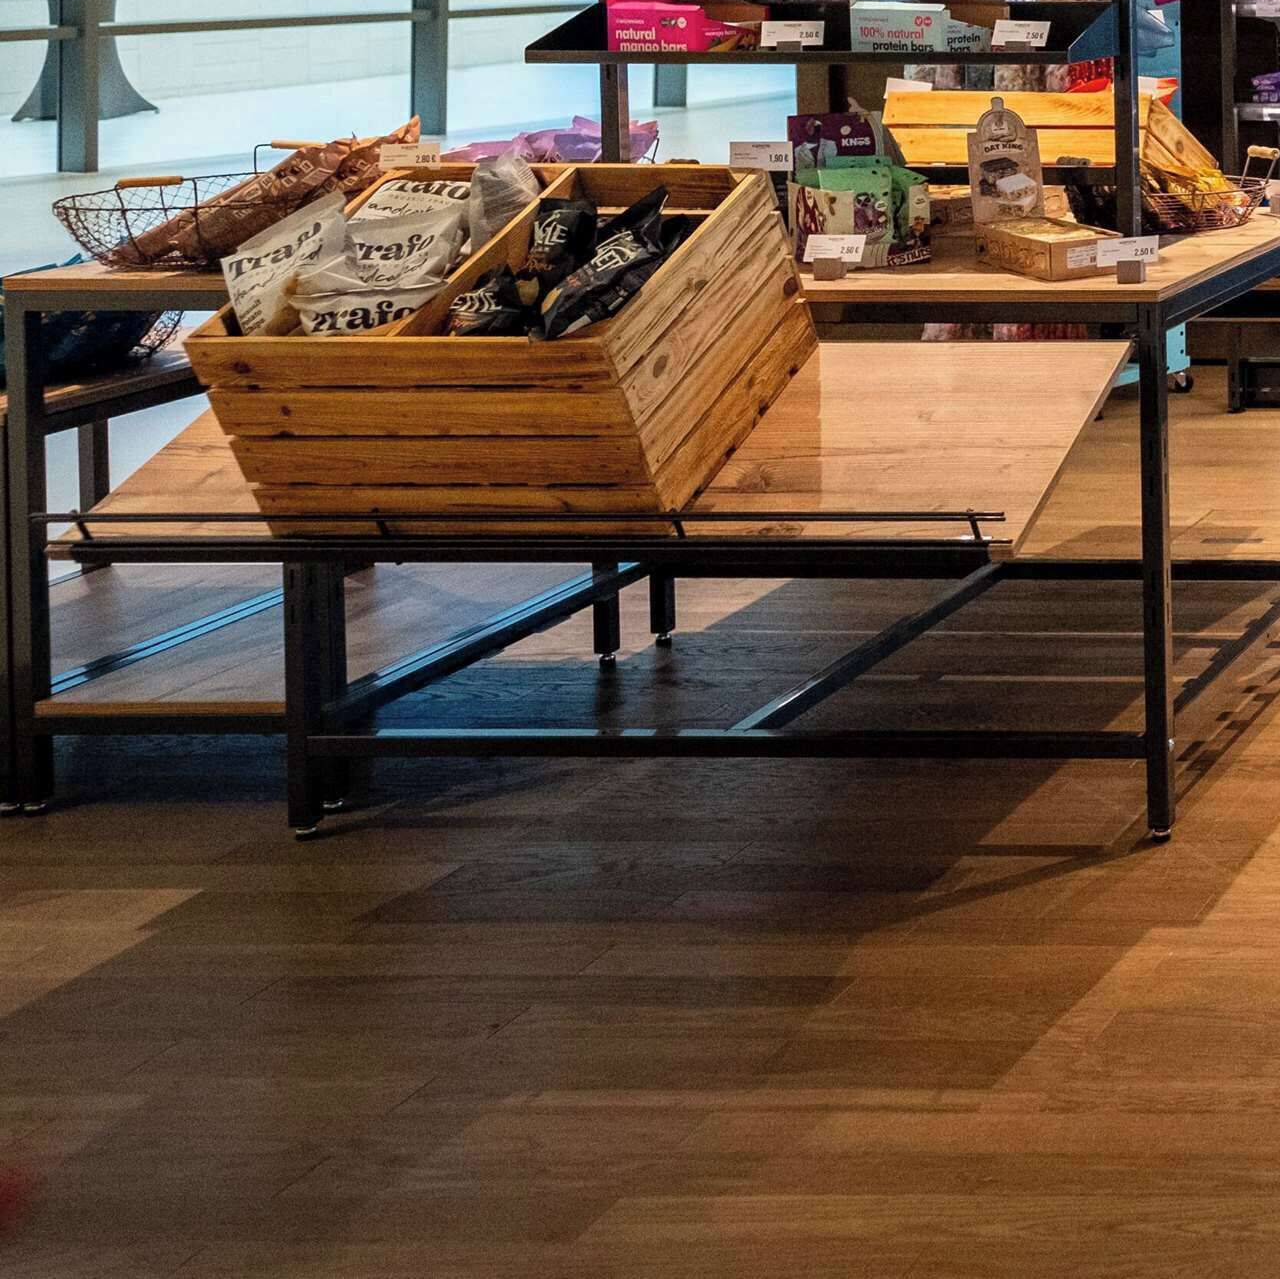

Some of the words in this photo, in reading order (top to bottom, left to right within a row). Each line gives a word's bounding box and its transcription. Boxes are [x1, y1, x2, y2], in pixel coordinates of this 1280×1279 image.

[615, 27, 656, 40] natural
[887, 27, 924, 39] natural
[947, 33, 981, 44] protein
[661, 40, 688, 52] bars
[872, 41, 908, 52] protein
[911, 40, 934, 52] bars
